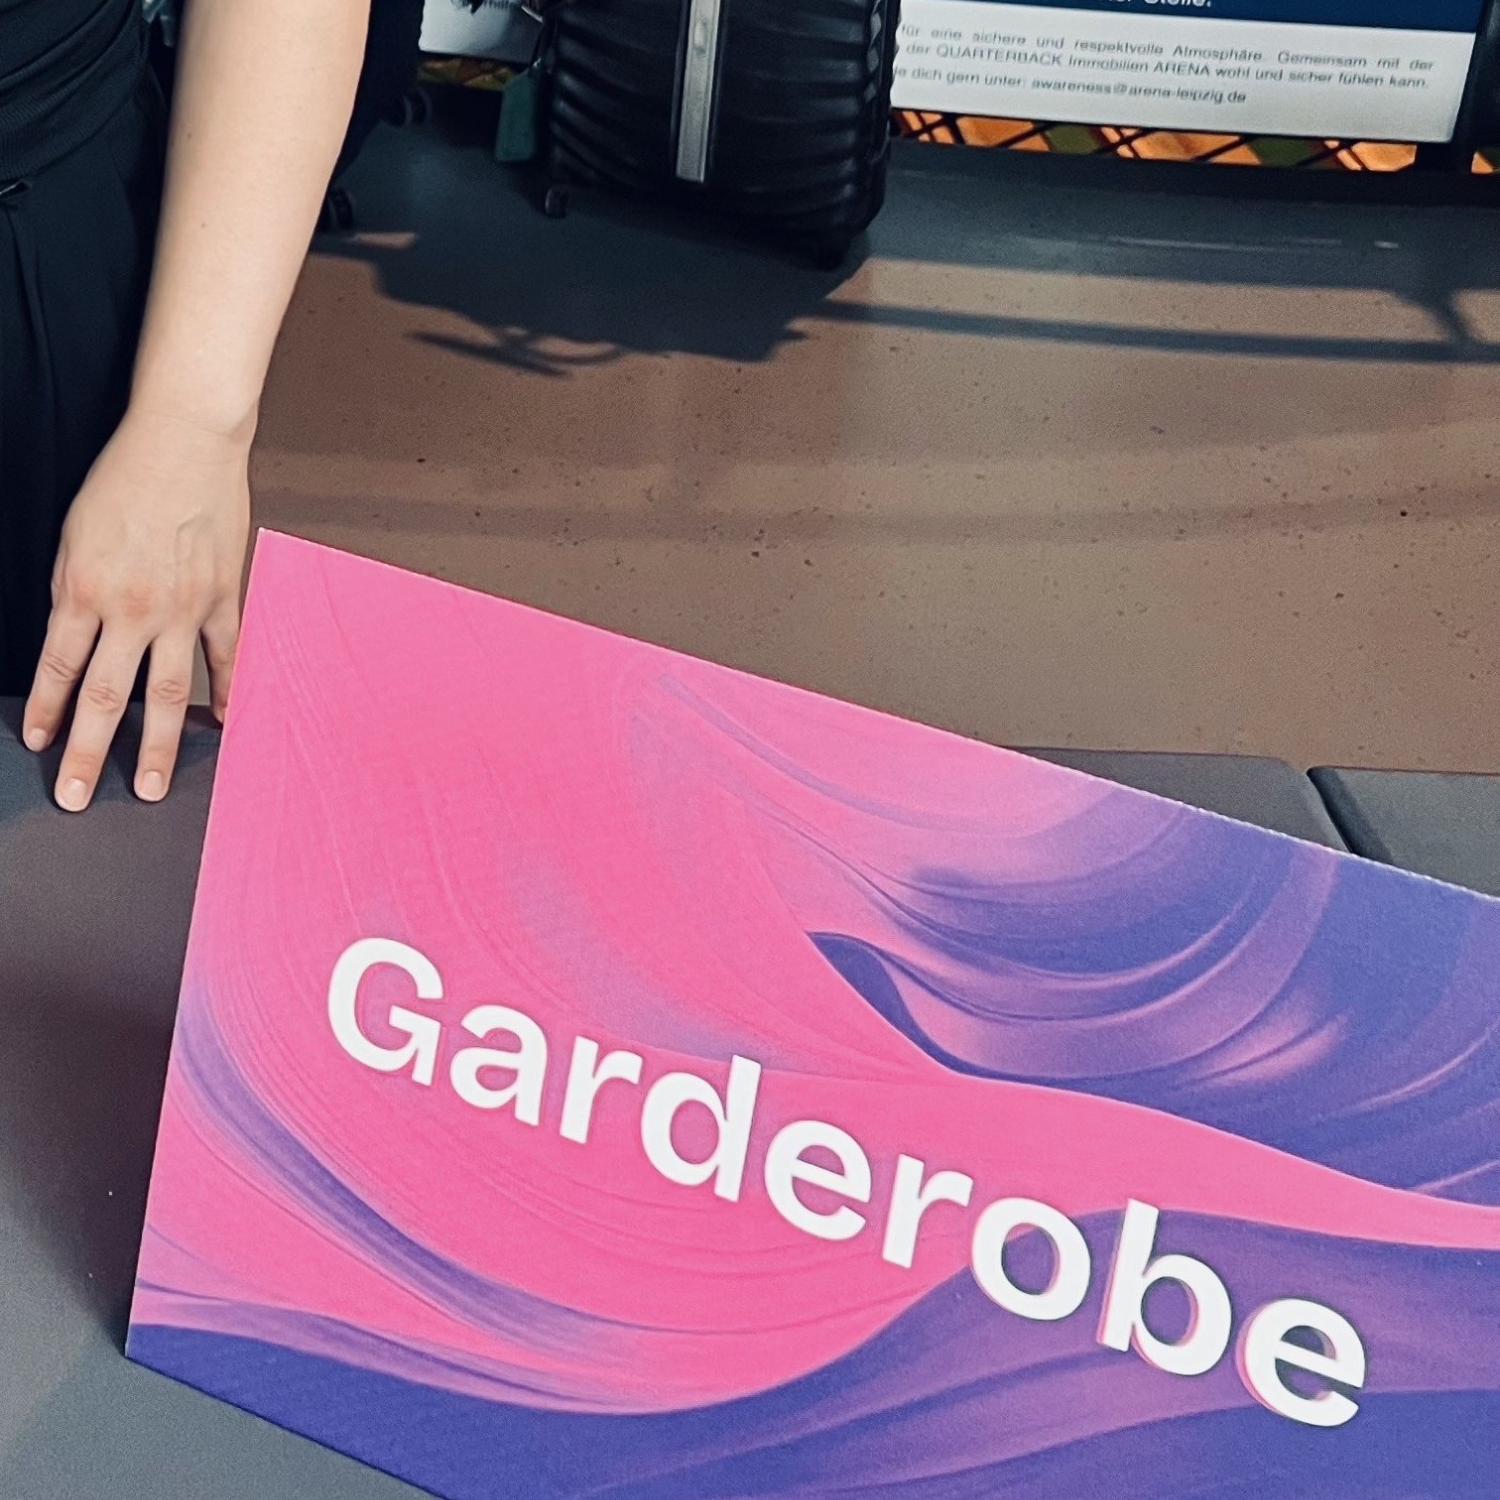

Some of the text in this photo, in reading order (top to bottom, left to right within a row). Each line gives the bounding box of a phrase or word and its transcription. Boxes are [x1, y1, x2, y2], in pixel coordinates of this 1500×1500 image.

[936, 44, 1063, 67] QUARTERBACK
[1153, 61, 1210, 76] ARENA
[327, 937, 1367, 1427] Garderobe
